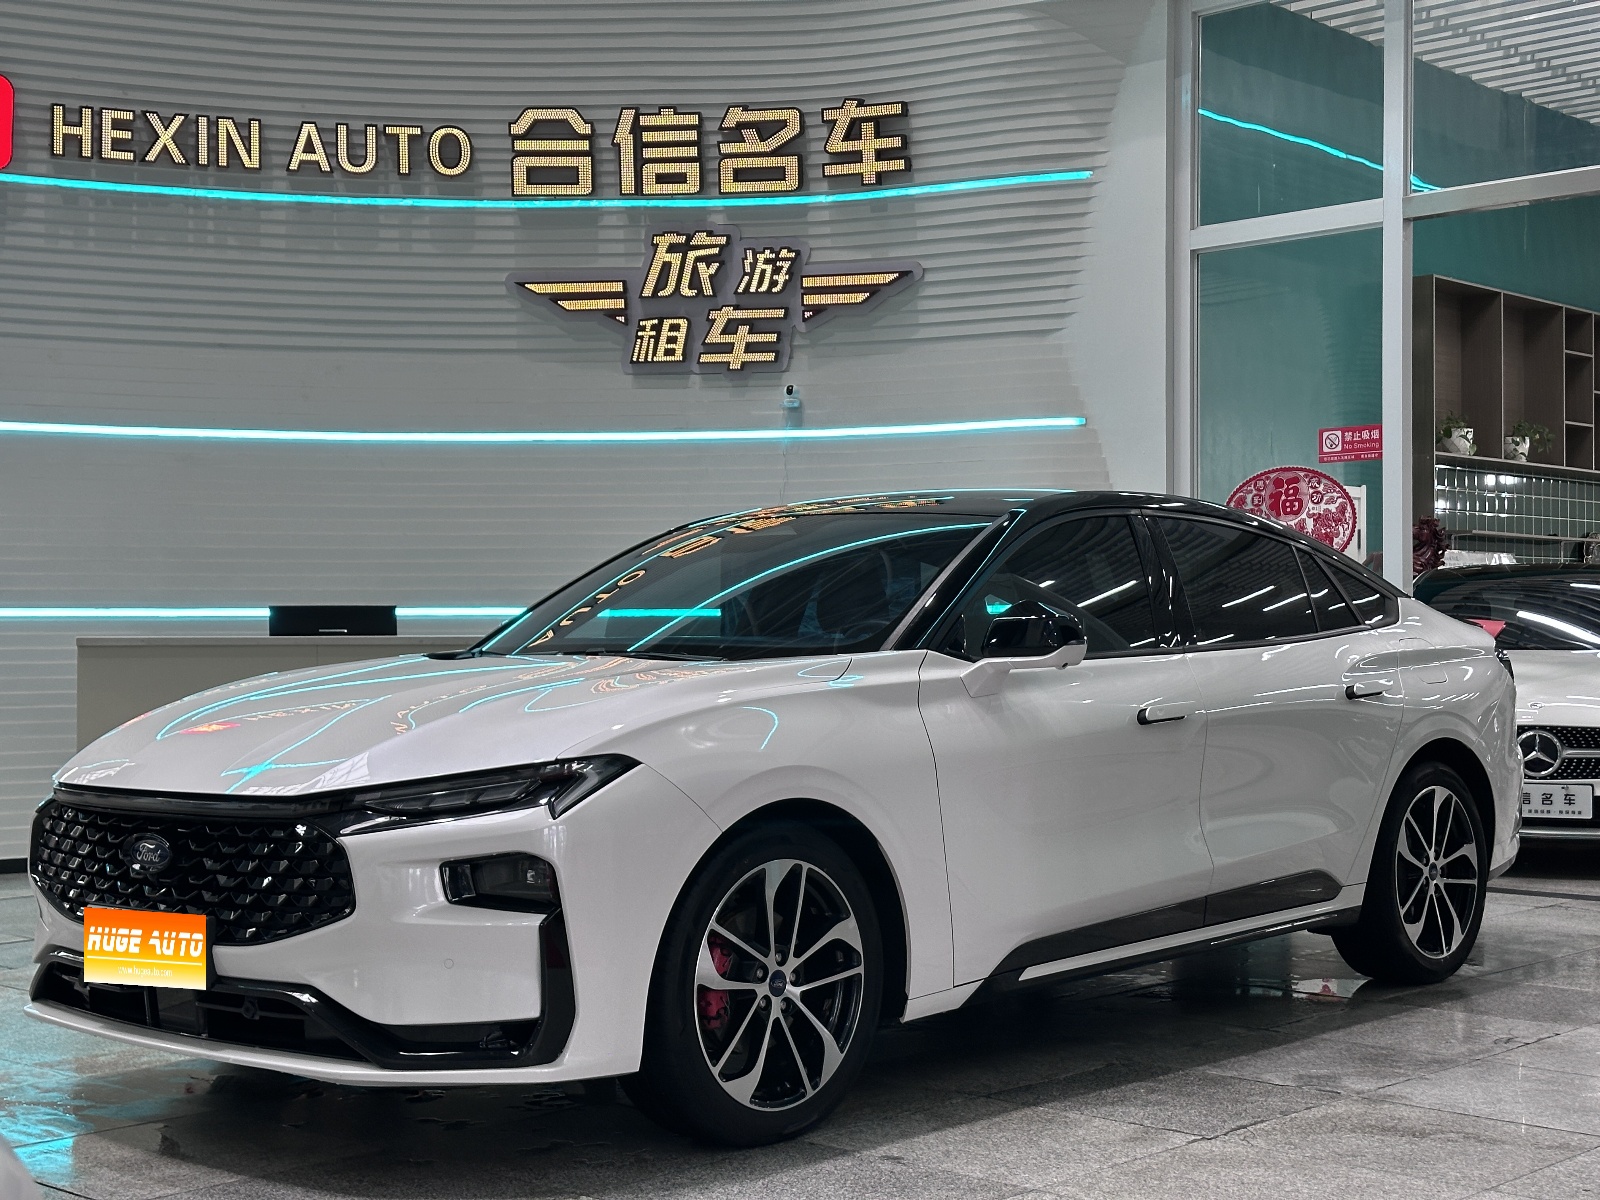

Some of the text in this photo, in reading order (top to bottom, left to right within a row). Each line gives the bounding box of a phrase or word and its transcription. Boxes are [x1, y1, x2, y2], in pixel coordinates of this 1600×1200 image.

[50, 103, 475, 177] HEXIN AUTO
[508, 98, 911, 197] 合信名车
[639, 230, 801, 298] 旅游
[629, 305, 789, 371] 租车
[1344, 429, 1380, 442] 禁止吸烟
[1353, 441, 1380, 449] Smoking
[1268, 476, 1304, 517] 福
[136, 842, 161, 862] Ford
